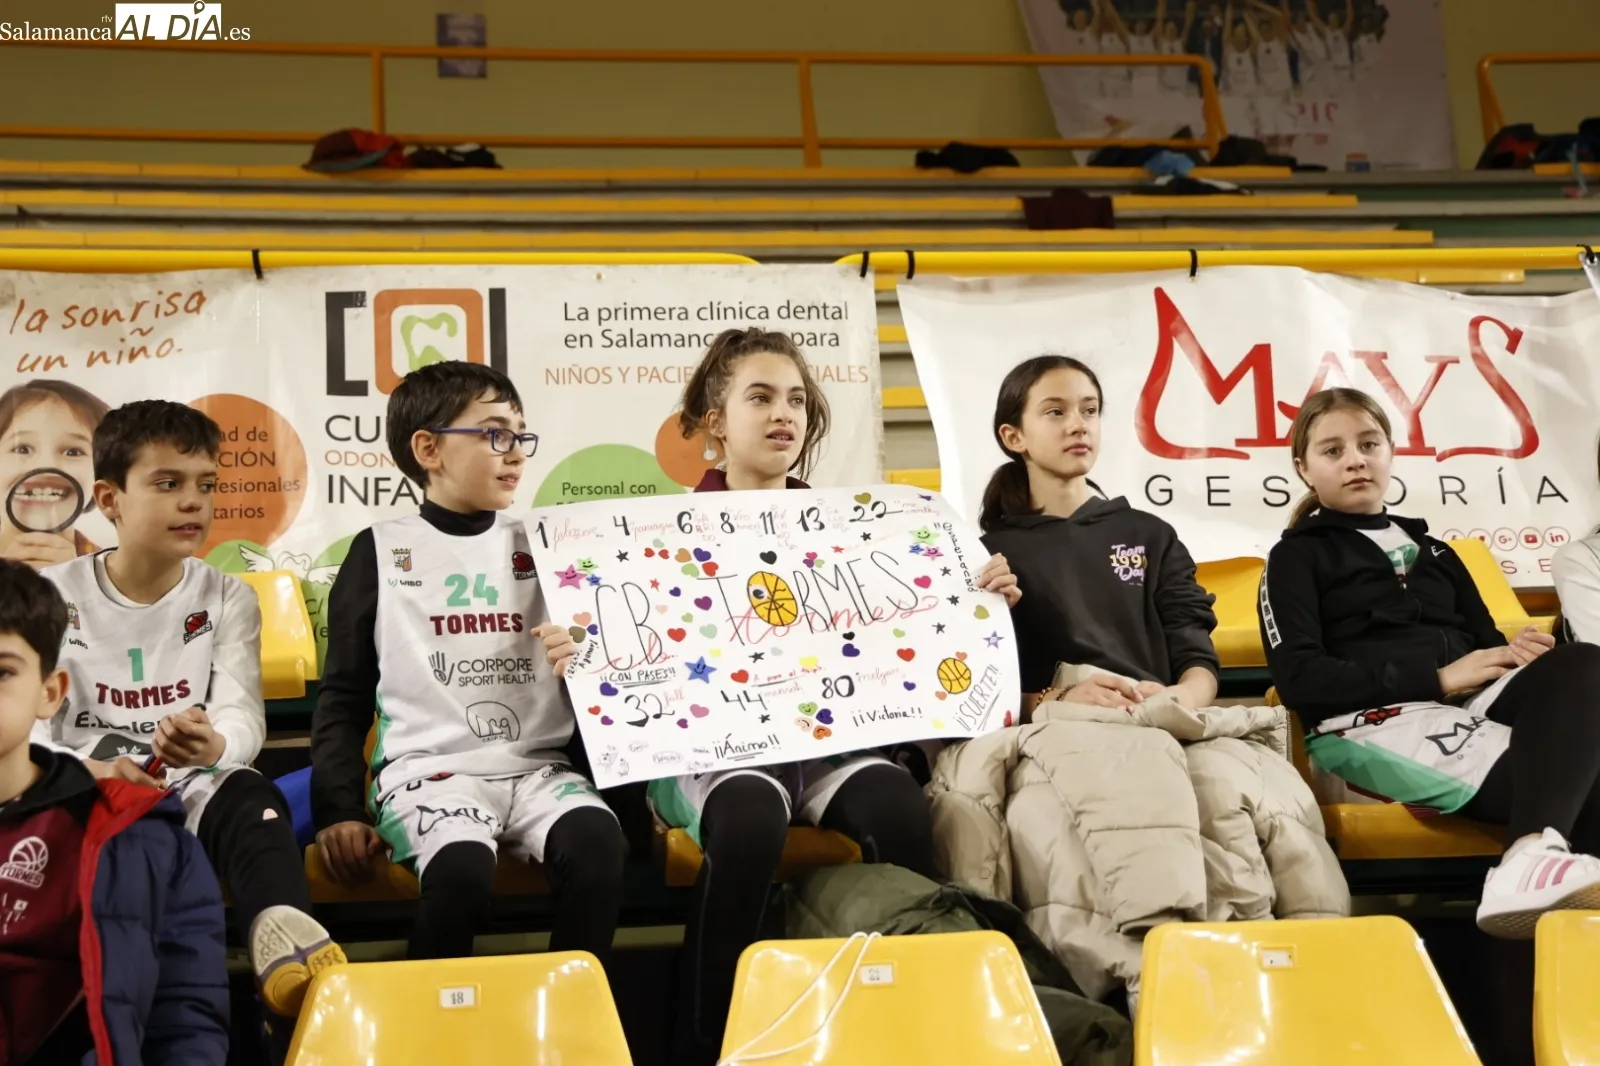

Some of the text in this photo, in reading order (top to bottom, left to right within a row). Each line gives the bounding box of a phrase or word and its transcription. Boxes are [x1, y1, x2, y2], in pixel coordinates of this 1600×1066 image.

[9, 289, 208, 335] la sonrisa
[563, 299, 848, 326] La primera clínica dental
[16, 326, 183, 373] un niño.
[563, 333, 593, 349] en
[600, 328, 714, 348] Salamanc
[544, 362, 613, 386] NIÑOS
[618, 366, 631, 384] Y
[637, 365, 693, 384] PACIE
[246, 426, 269, 443] de
[324, 449, 397, 468] ODON
[327, 474, 421, 506] INFA
[561, 481, 657, 496] Personal con
[534, 520, 549, 549] 1
[613, 515, 631, 537] 4
[676, 510, 693, 535] 6
[719, 511, 736, 535] 8
[759, 510, 776, 535] 11
[796, 506, 826, 533] 13
[848, 500, 904, 523] 22
[1110, 543, 1146, 559] Team
[444, 573, 500, 607] 24
[429, 612, 524, 637] TORMES
[127, 647, 144, 683] 1
[456, 658, 534, 675] CORPORE
[457, 672, 537, 688] SPORT HEALTH
[821, 674, 856, 700] 80
[95, 678, 192, 710] TORMES
[719, 690, 768, 712] 44
[624, 693, 676, 728] 32
